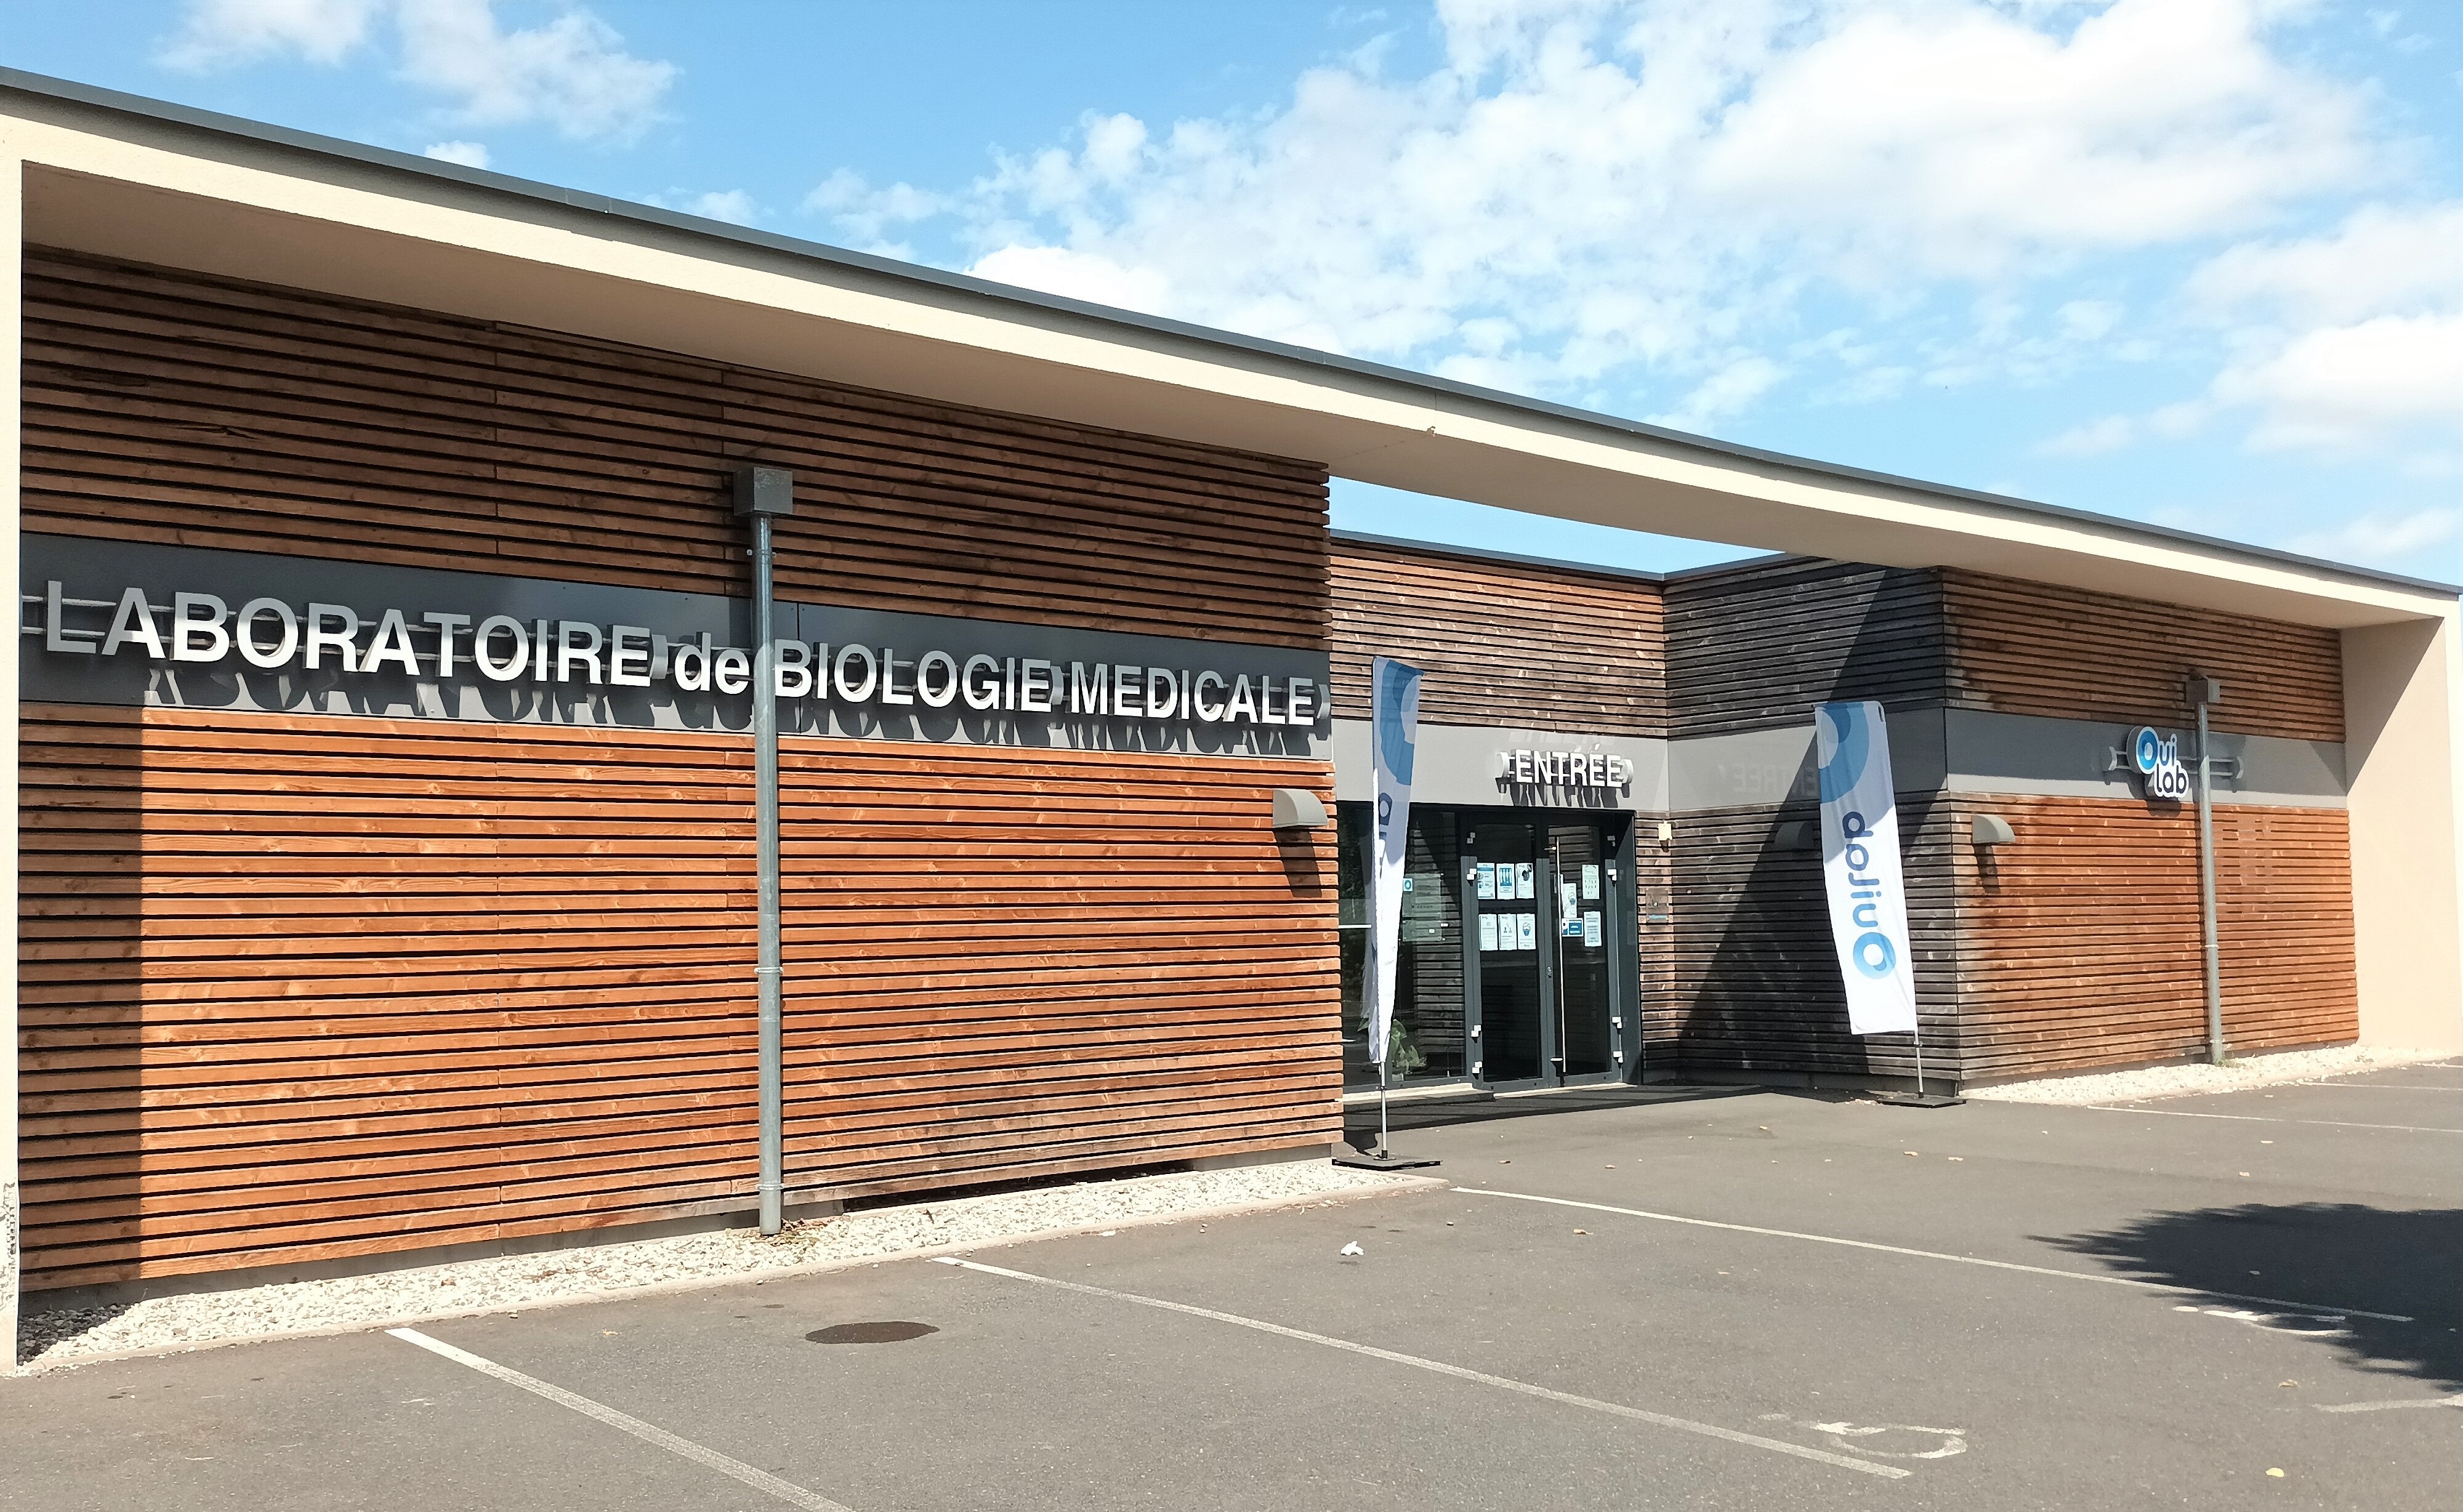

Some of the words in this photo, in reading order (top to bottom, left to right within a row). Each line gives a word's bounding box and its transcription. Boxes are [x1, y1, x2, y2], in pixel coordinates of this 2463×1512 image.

[47, 581, 650, 686] LABORATOIRE
[675, 632, 749, 694] de
[775, 639, 1052, 712] BIOLOGIE
[1071, 661, 1314, 726] MEDICALE
